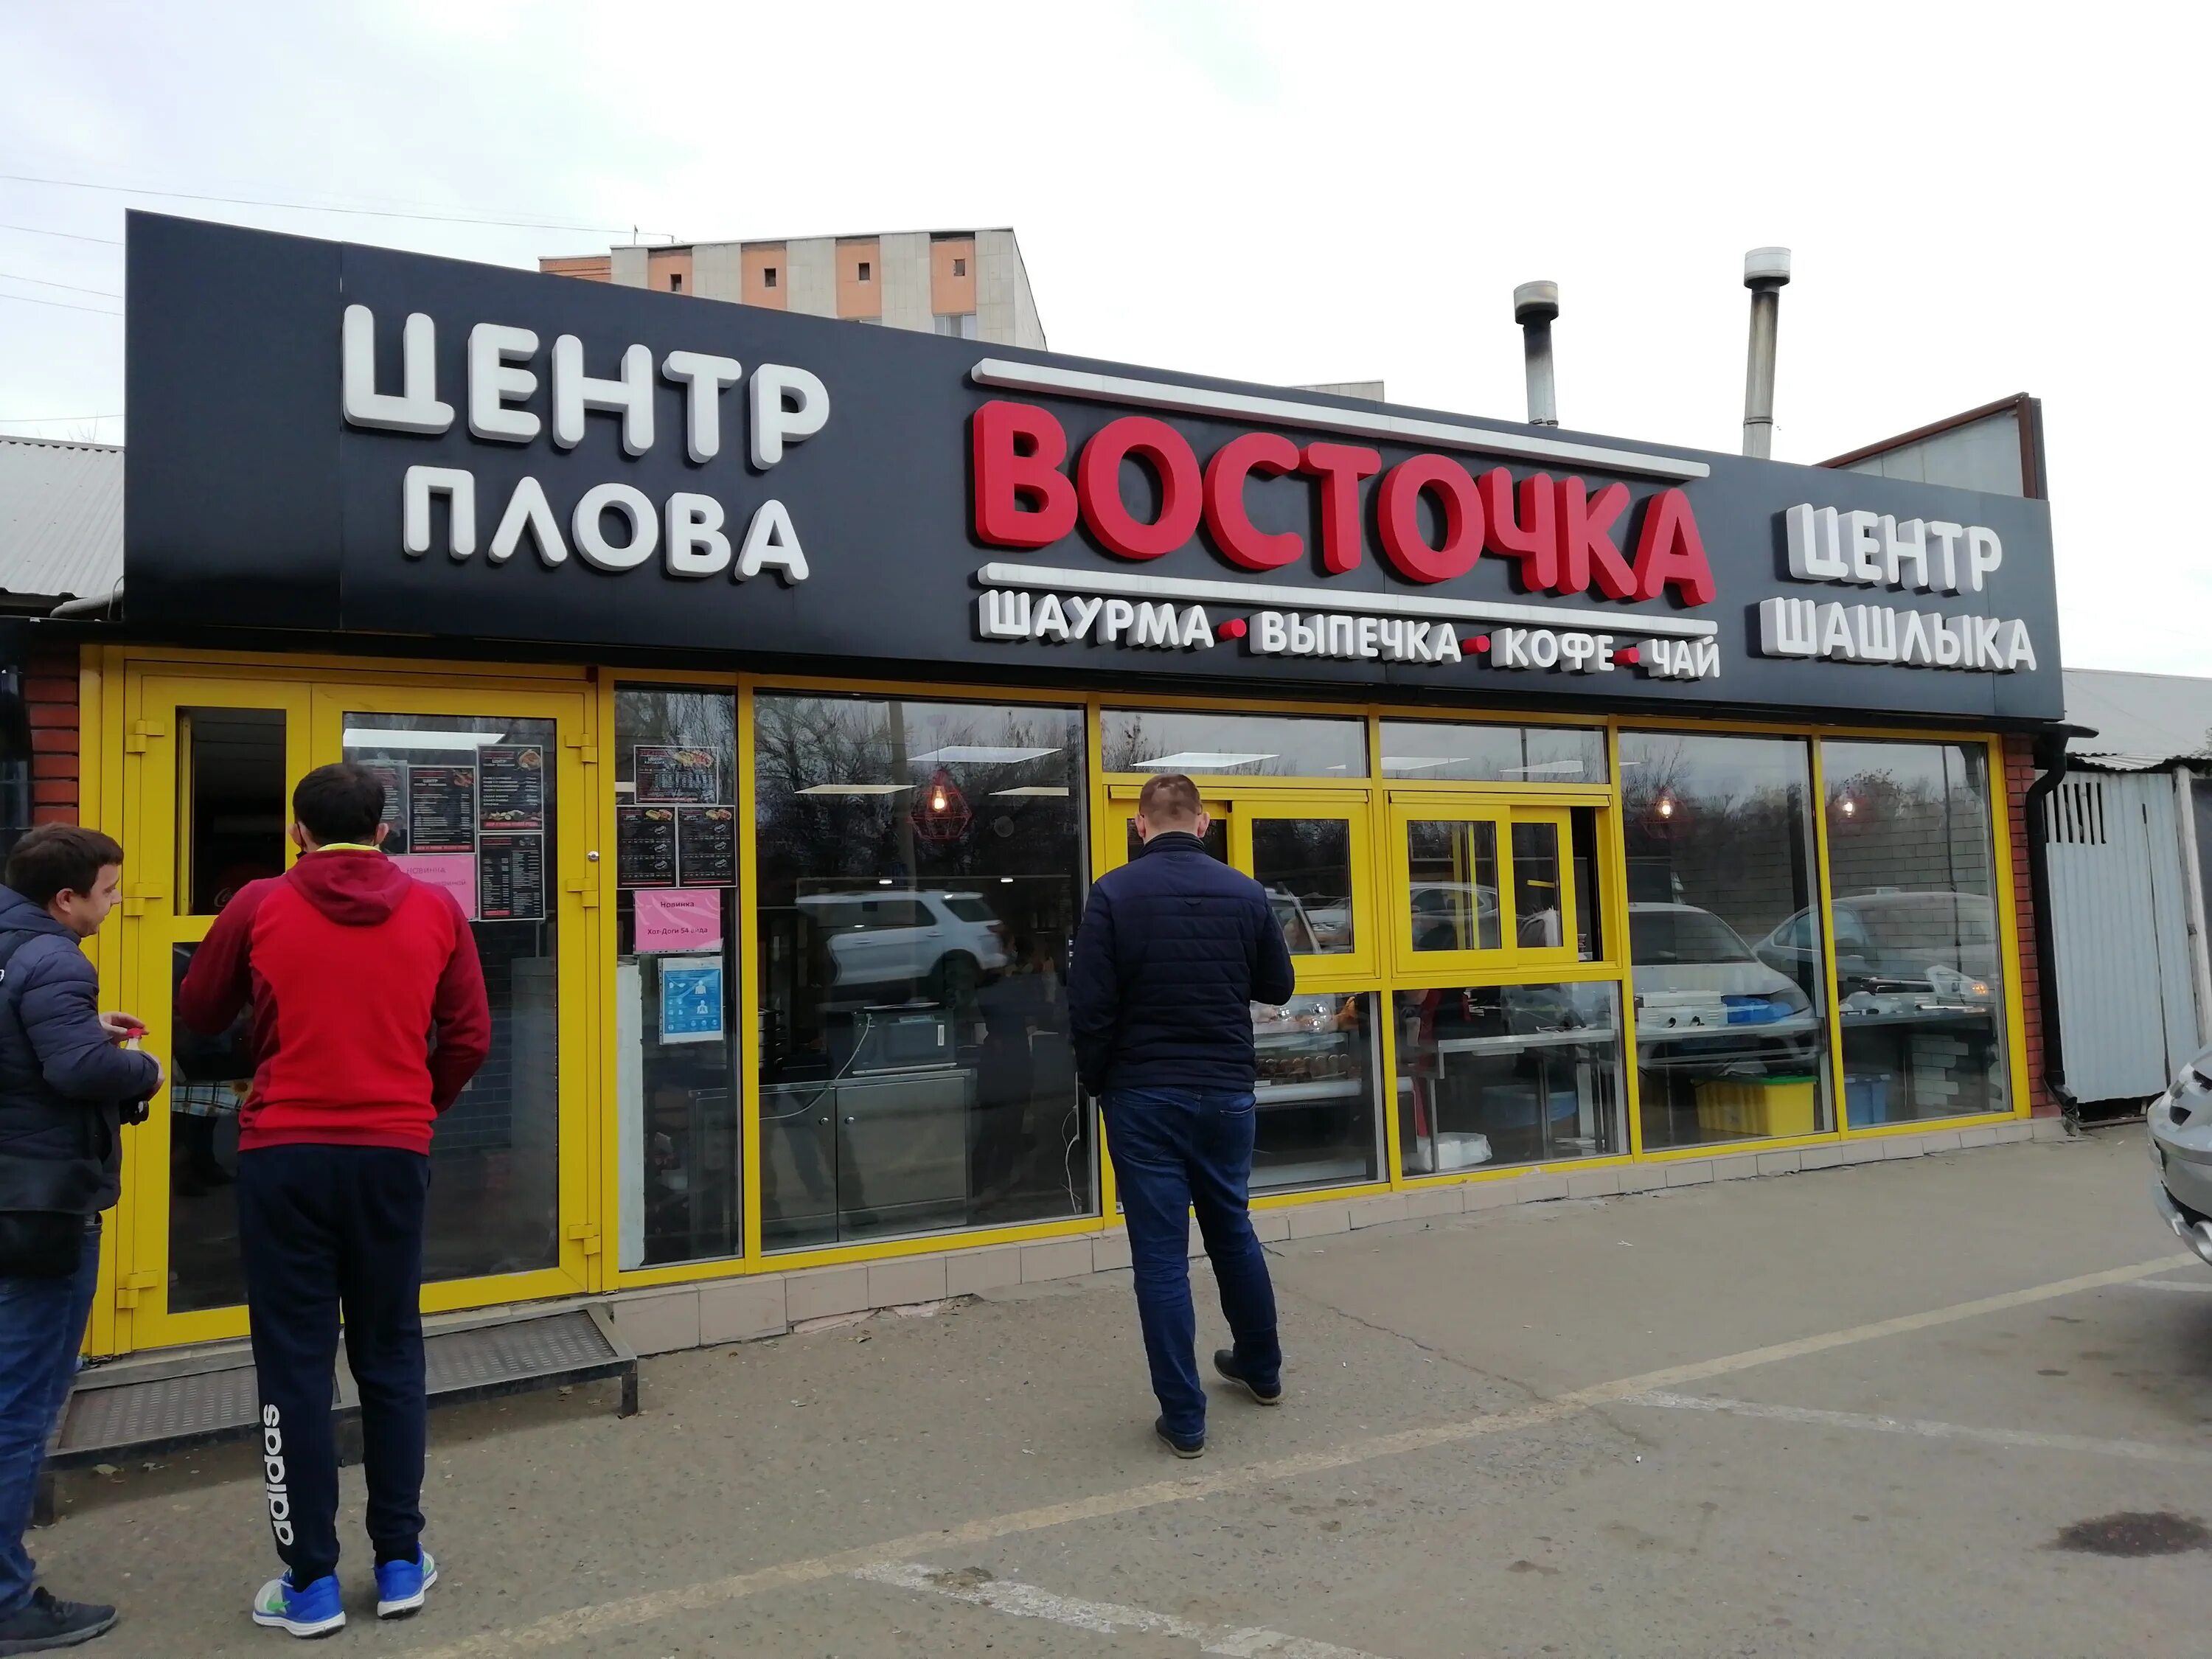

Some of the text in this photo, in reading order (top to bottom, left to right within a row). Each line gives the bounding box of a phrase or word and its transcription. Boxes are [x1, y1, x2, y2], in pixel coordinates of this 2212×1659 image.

[342, 304, 830, 471] ЦЕНТР
[403, 465, 810, 585] ПЛОВА
[973, 399, 1717, 608] ВОСТОЧКА
[1785, 502, 2003, 596] ЦЕНТР
[978, 589, 1721, 680] ШАУРМА ВЫПЕЧКА КОФЕ ЧАЙ
[1759, 596, 2037, 672] ШАШЛЫКА
[262, 1402, 294, 1547] adidas
